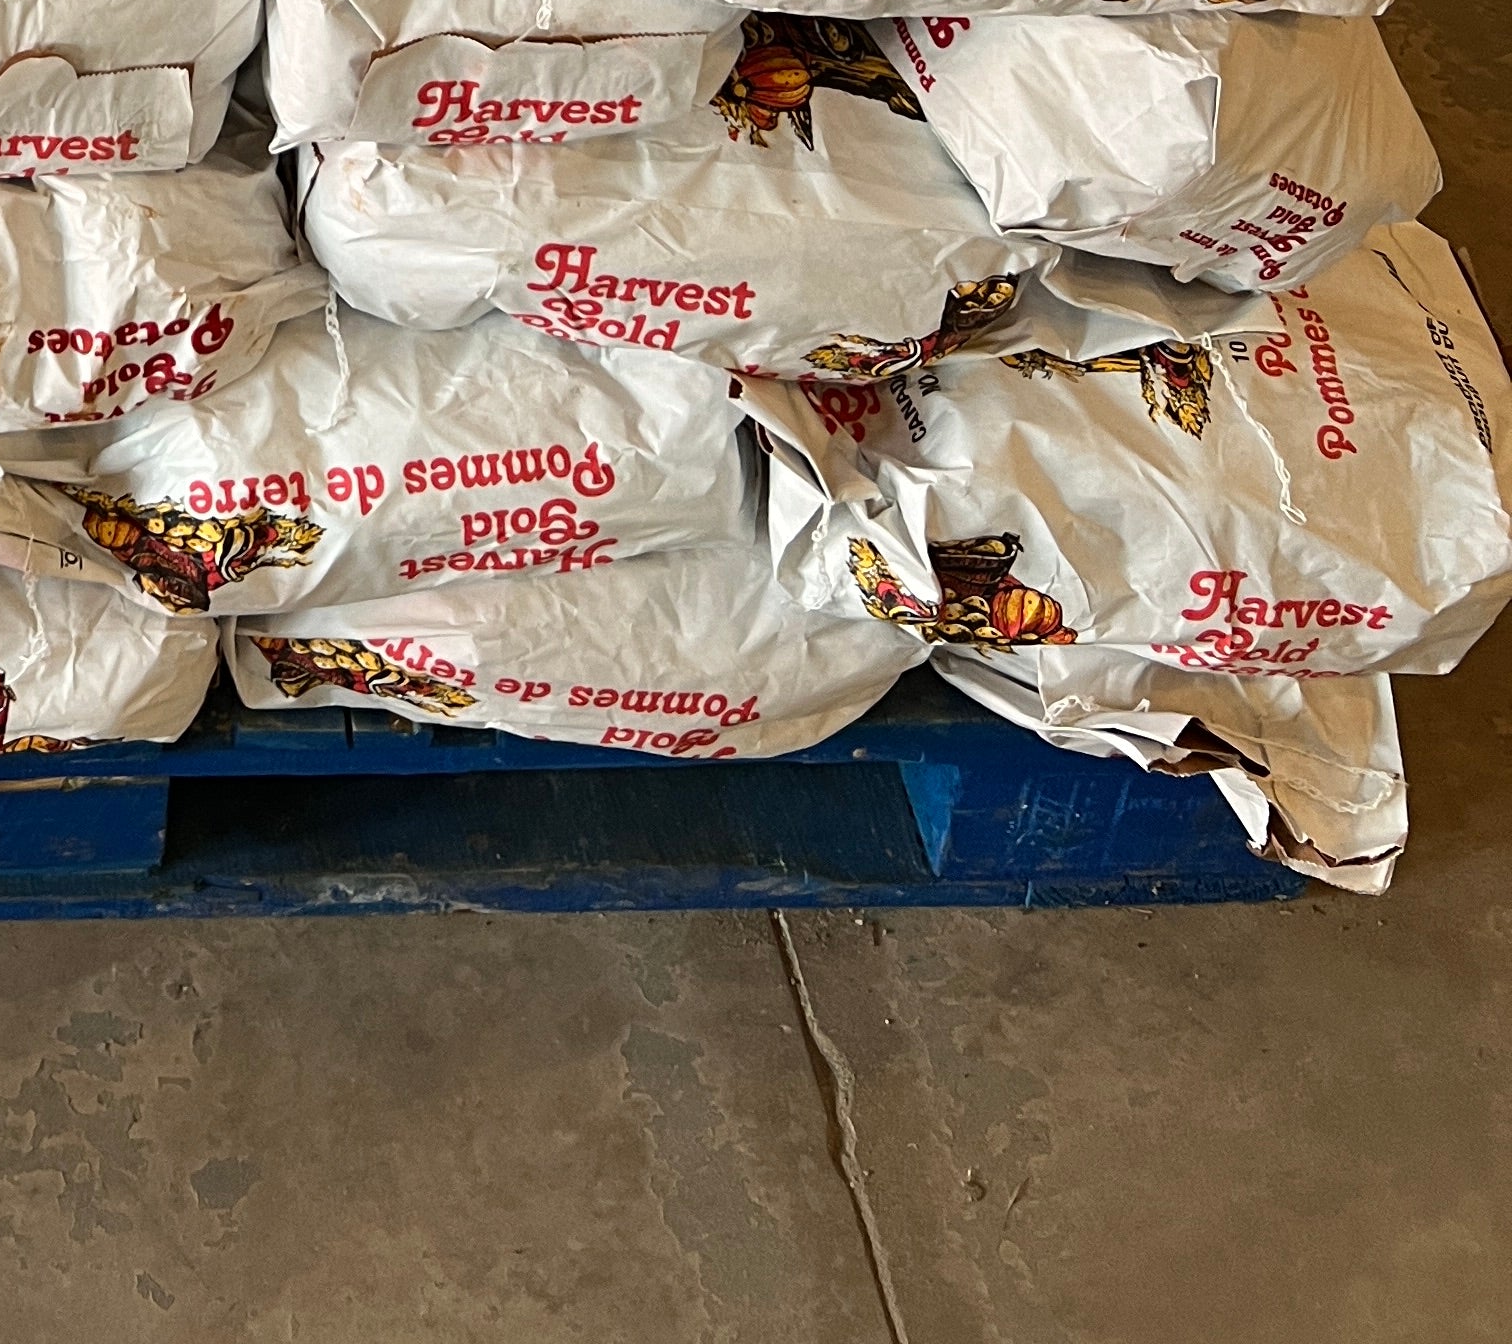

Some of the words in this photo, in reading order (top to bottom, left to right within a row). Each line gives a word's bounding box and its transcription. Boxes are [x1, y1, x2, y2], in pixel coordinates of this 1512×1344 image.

[411, 80, 641, 129] Harvest
[1266, 205, 1316, 234] Gold
[1268, 172, 1347, 227] Potatoes
[528, 242, 755, 320] Harvest
[27, 303, 234, 364] Potatoes
[540, 295, 682, 352] Gold
[1229, 340, 1250, 363] 10
[82, 352, 193, 404] Gold
[1296, 307, 1358, 460] Pommes
[188, 472, 311, 516] terre
[325, 460, 386, 514] de
[403, 441, 615, 498] Pommes
[461, 497, 603, 547] Gold
[399, 538, 618, 580] Harvest
[1182, 569, 1395, 632] Harvest
[493, 675, 552, 703] de
[569, 683, 762, 728] Pommes
